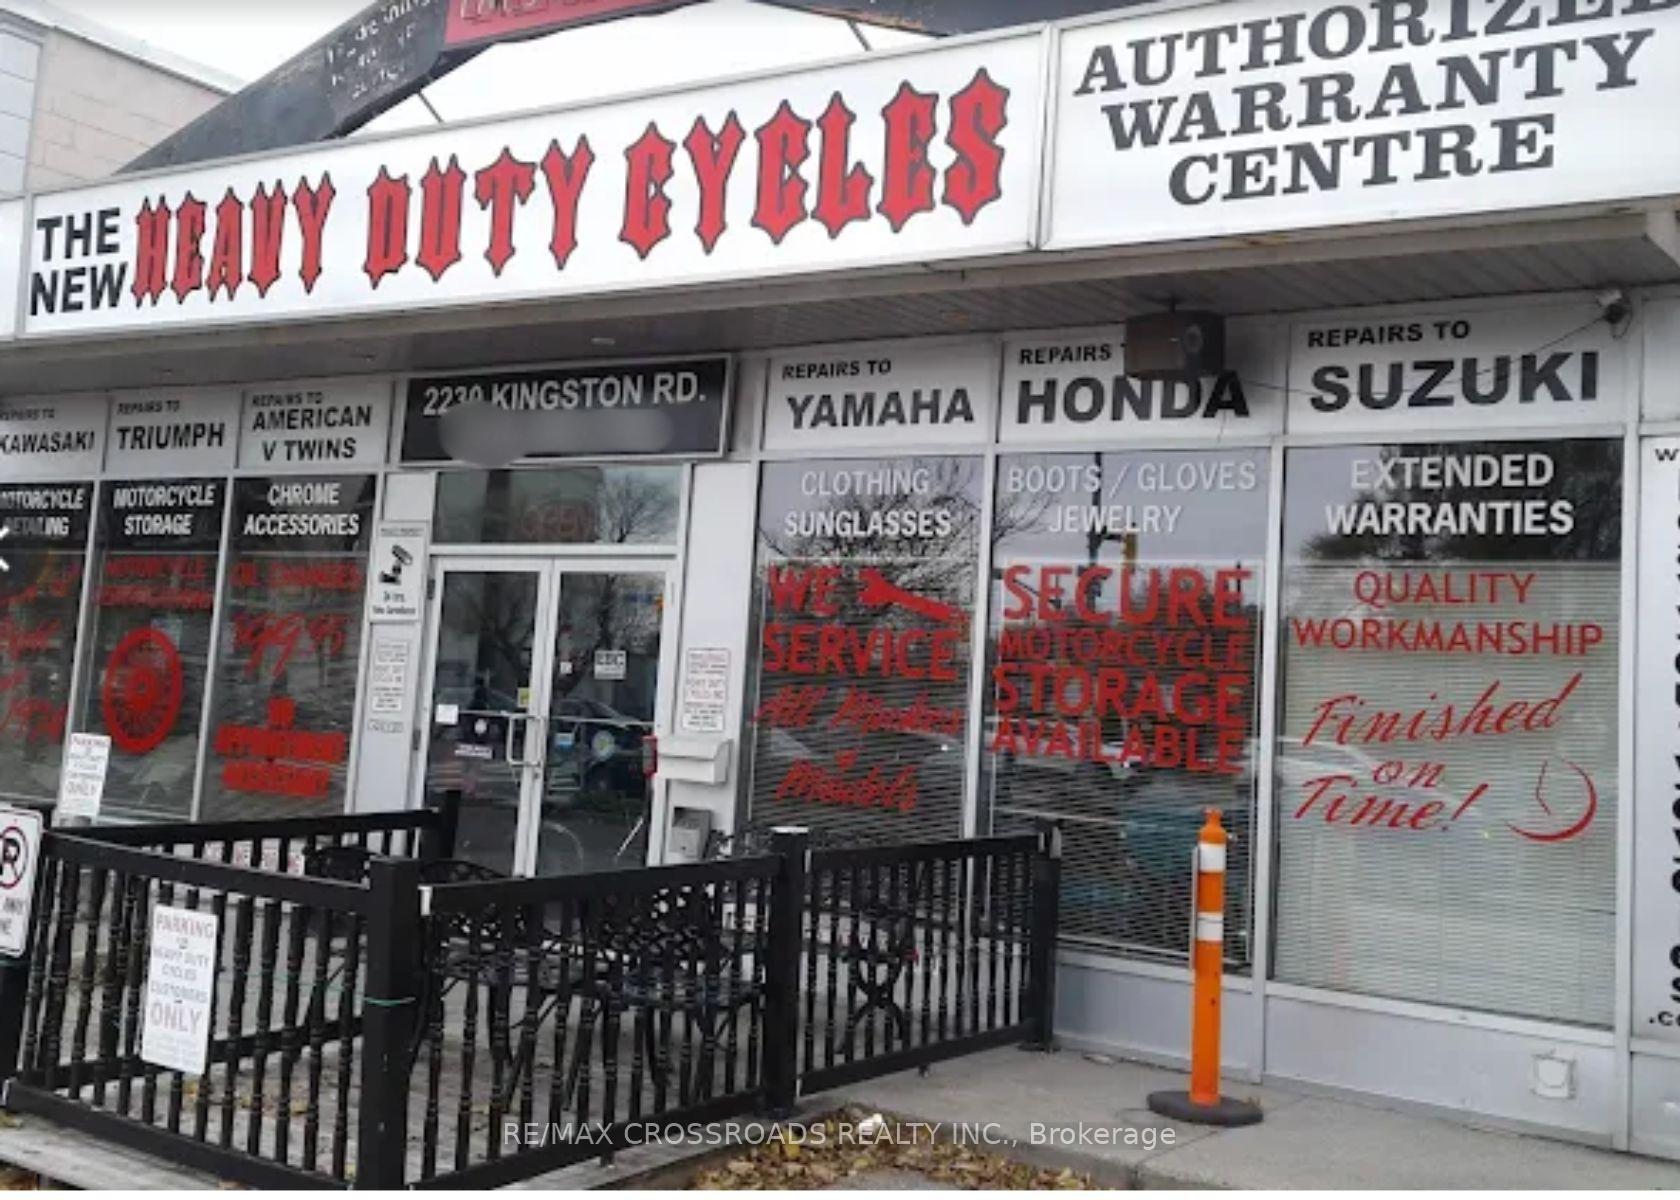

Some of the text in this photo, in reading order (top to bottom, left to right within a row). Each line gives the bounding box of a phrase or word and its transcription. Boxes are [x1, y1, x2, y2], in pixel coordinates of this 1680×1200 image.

[1073, 0, 1680, 95] AUTHORIZE
[1100, 29, 1654, 151] WARRANTY
[1169, 113, 1555, 205] CENTRE
[131, 67, 1010, 309] HEAVY DUTY CYCLES
[36, 207, 120, 262] THE
[30, 261, 127, 316] NEW
[1308, 320, 1470, 347] REPAIRS TO
[782, 358, 892, 380] REPAIRS TO
[1019, 344, 1111, 365] REPAIRS
[491, 375, 643, 411] KINGSTON
[653, 371, 706, 404] RD.
[1017, 371, 1250, 424] HONDA
[1310, 351, 1599, 413] SUZUKI
[253, 404, 372, 431] AMERICAN
[786, 387, 975, 430] YAMAHA
[117, 422, 225, 449] TRIUMPH
[262, 437, 356, 461] V TWINS
[800, 466, 931, 498] CLOTHING
[1007, 464, 1100, 494] BOOTS
[1135, 461, 1257, 492] GLOVES
[1350, 453, 1554, 490] EXTENDED
[113, 484, 216, 508] MOTORCYCLE
[267, 482, 340, 506] CHROME
[124, 513, 194, 536] STORAGE
[244, 513, 359, 536] ACCESSORIES
[784, 509, 952, 540] SUNGLASSES
[1048, 505, 1181, 535] JEWELRY
[1325, 499, 1575, 536] WARRANTIES
[767, 563, 843, 617] WE
[1002, 565, 1253, 628] SECURE
[1354, 571, 1538, 608] QUALITY
[762, 623, 959, 682] SERVICE
[1000, 627, 1249, 671] MOTORCYCLE
[1292, 618, 1604, 656] WORKMANSHIP
[992, 663, 1249, 726] STORAGE
[1302, 672, 1584, 748] Finished
[992, 714, 1246, 775] AVAILABLE
[1372, 760, 1447, 789] on
[1294, 773, 1490, 832] Time!
[156, 914, 214, 939] PARKING
[151, 1003, 202, 1034] ONLY
